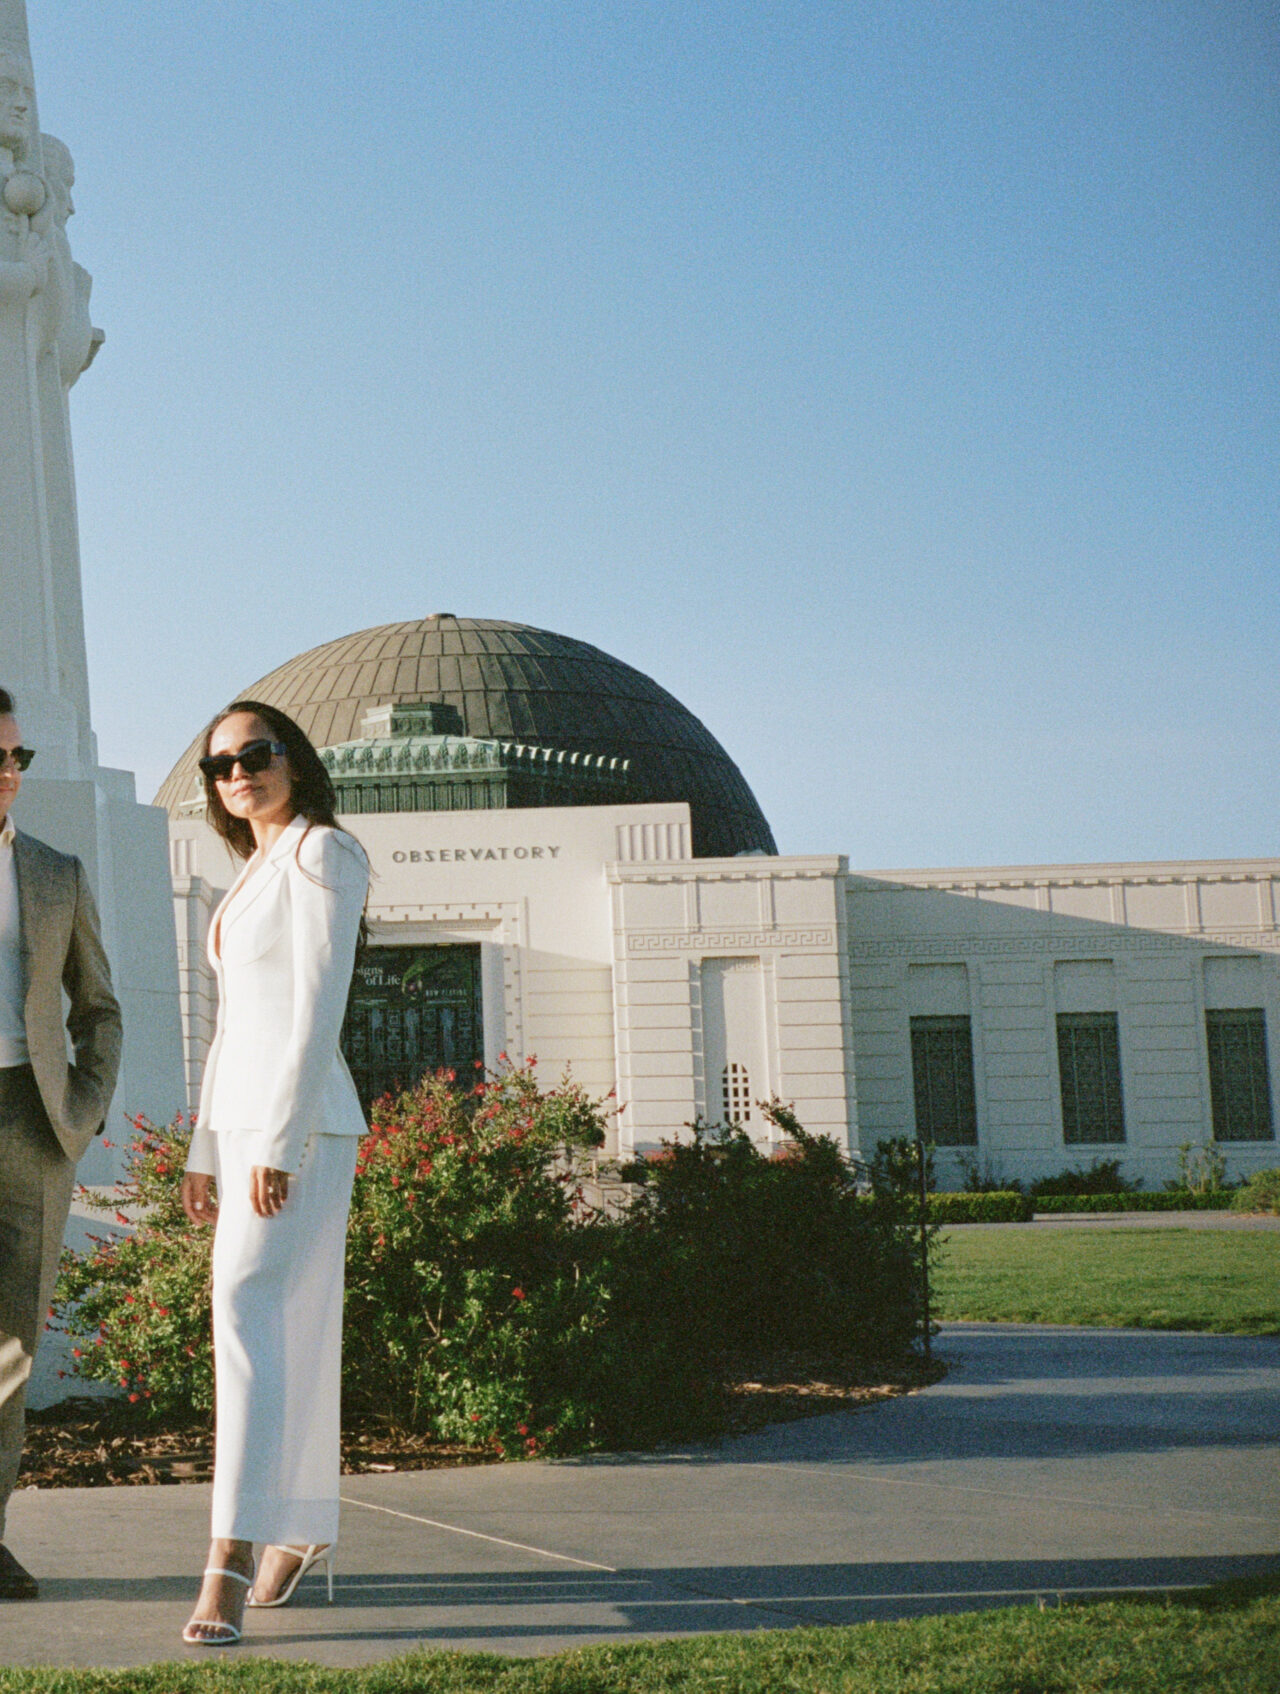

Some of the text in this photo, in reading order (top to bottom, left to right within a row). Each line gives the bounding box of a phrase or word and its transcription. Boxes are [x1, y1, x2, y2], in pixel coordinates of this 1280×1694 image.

[391, 846, 561, 864] OBSERVATORY
[365, 974, 401, 986] of Life
